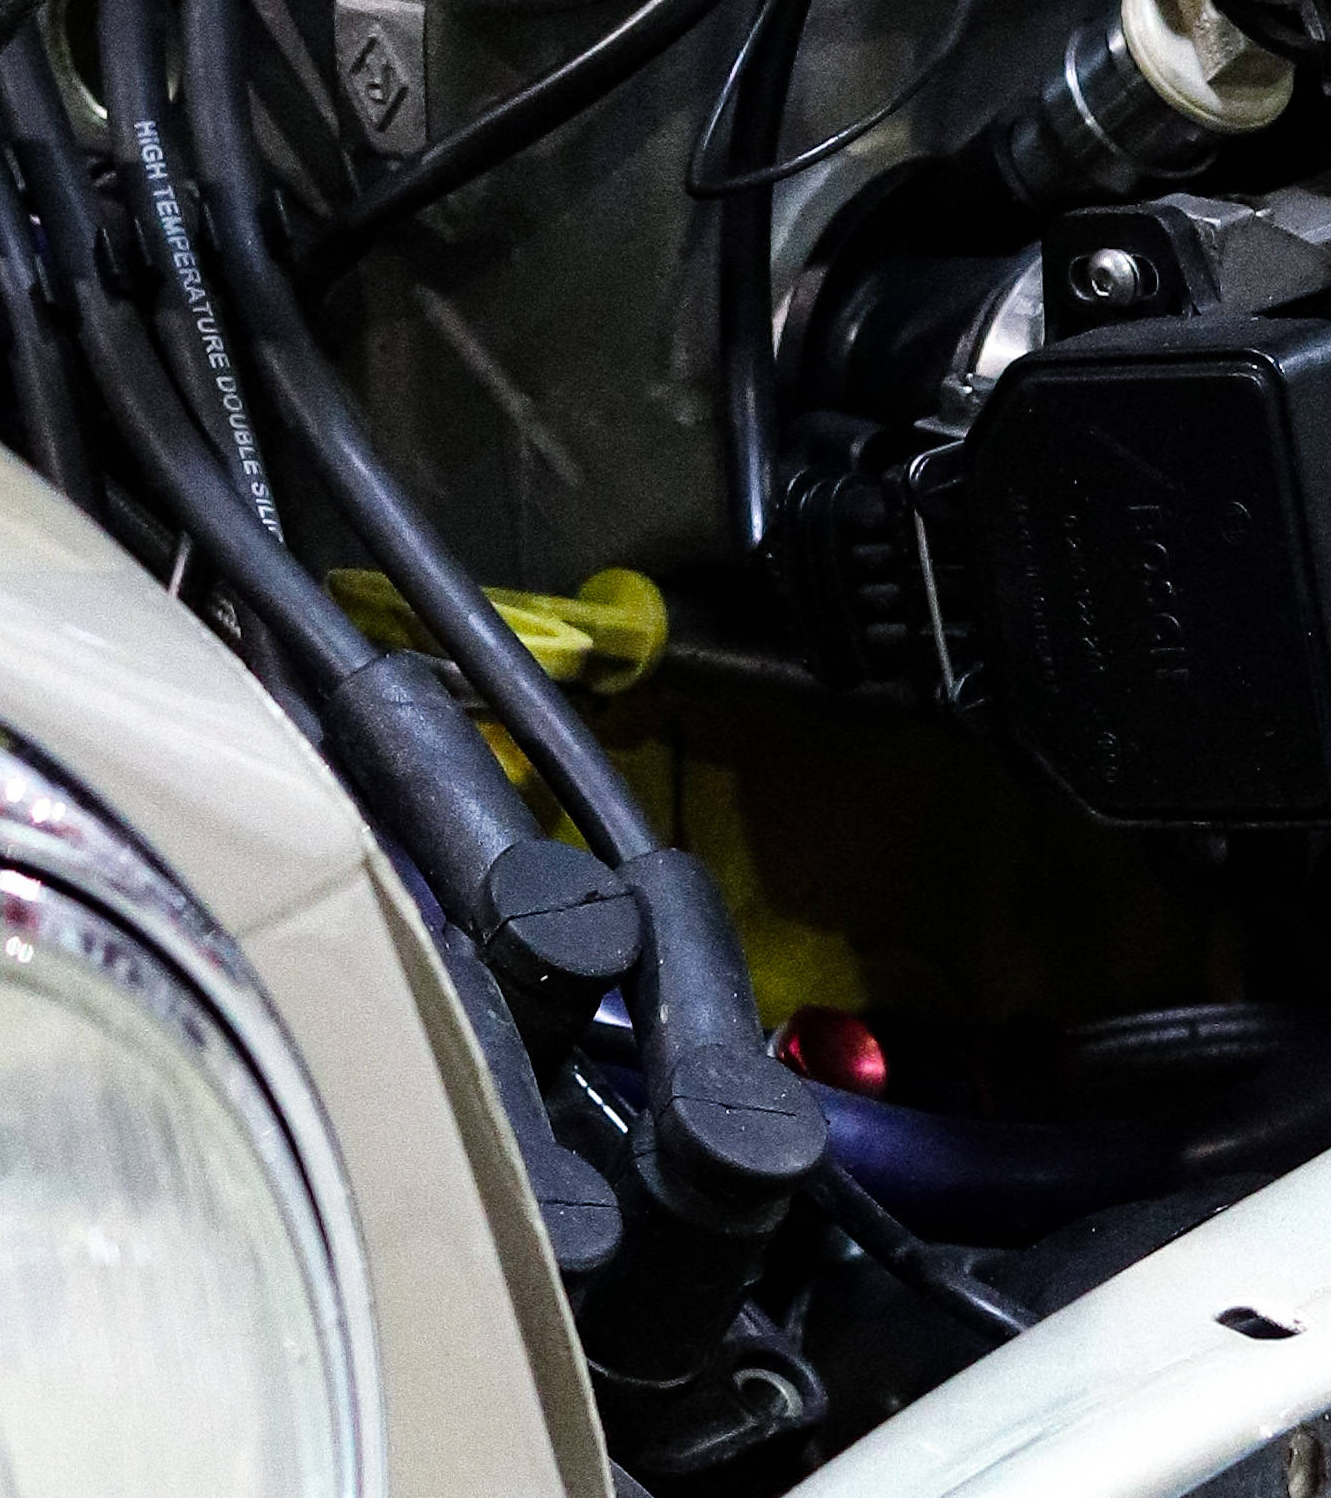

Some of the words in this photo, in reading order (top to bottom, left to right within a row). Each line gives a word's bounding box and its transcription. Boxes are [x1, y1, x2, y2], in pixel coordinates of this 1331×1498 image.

[134, 120, 167, 180] HIGH
[152, 184, 230, 368] TEMPERATURE
[217, 376, 262, 475] DOUBLE
